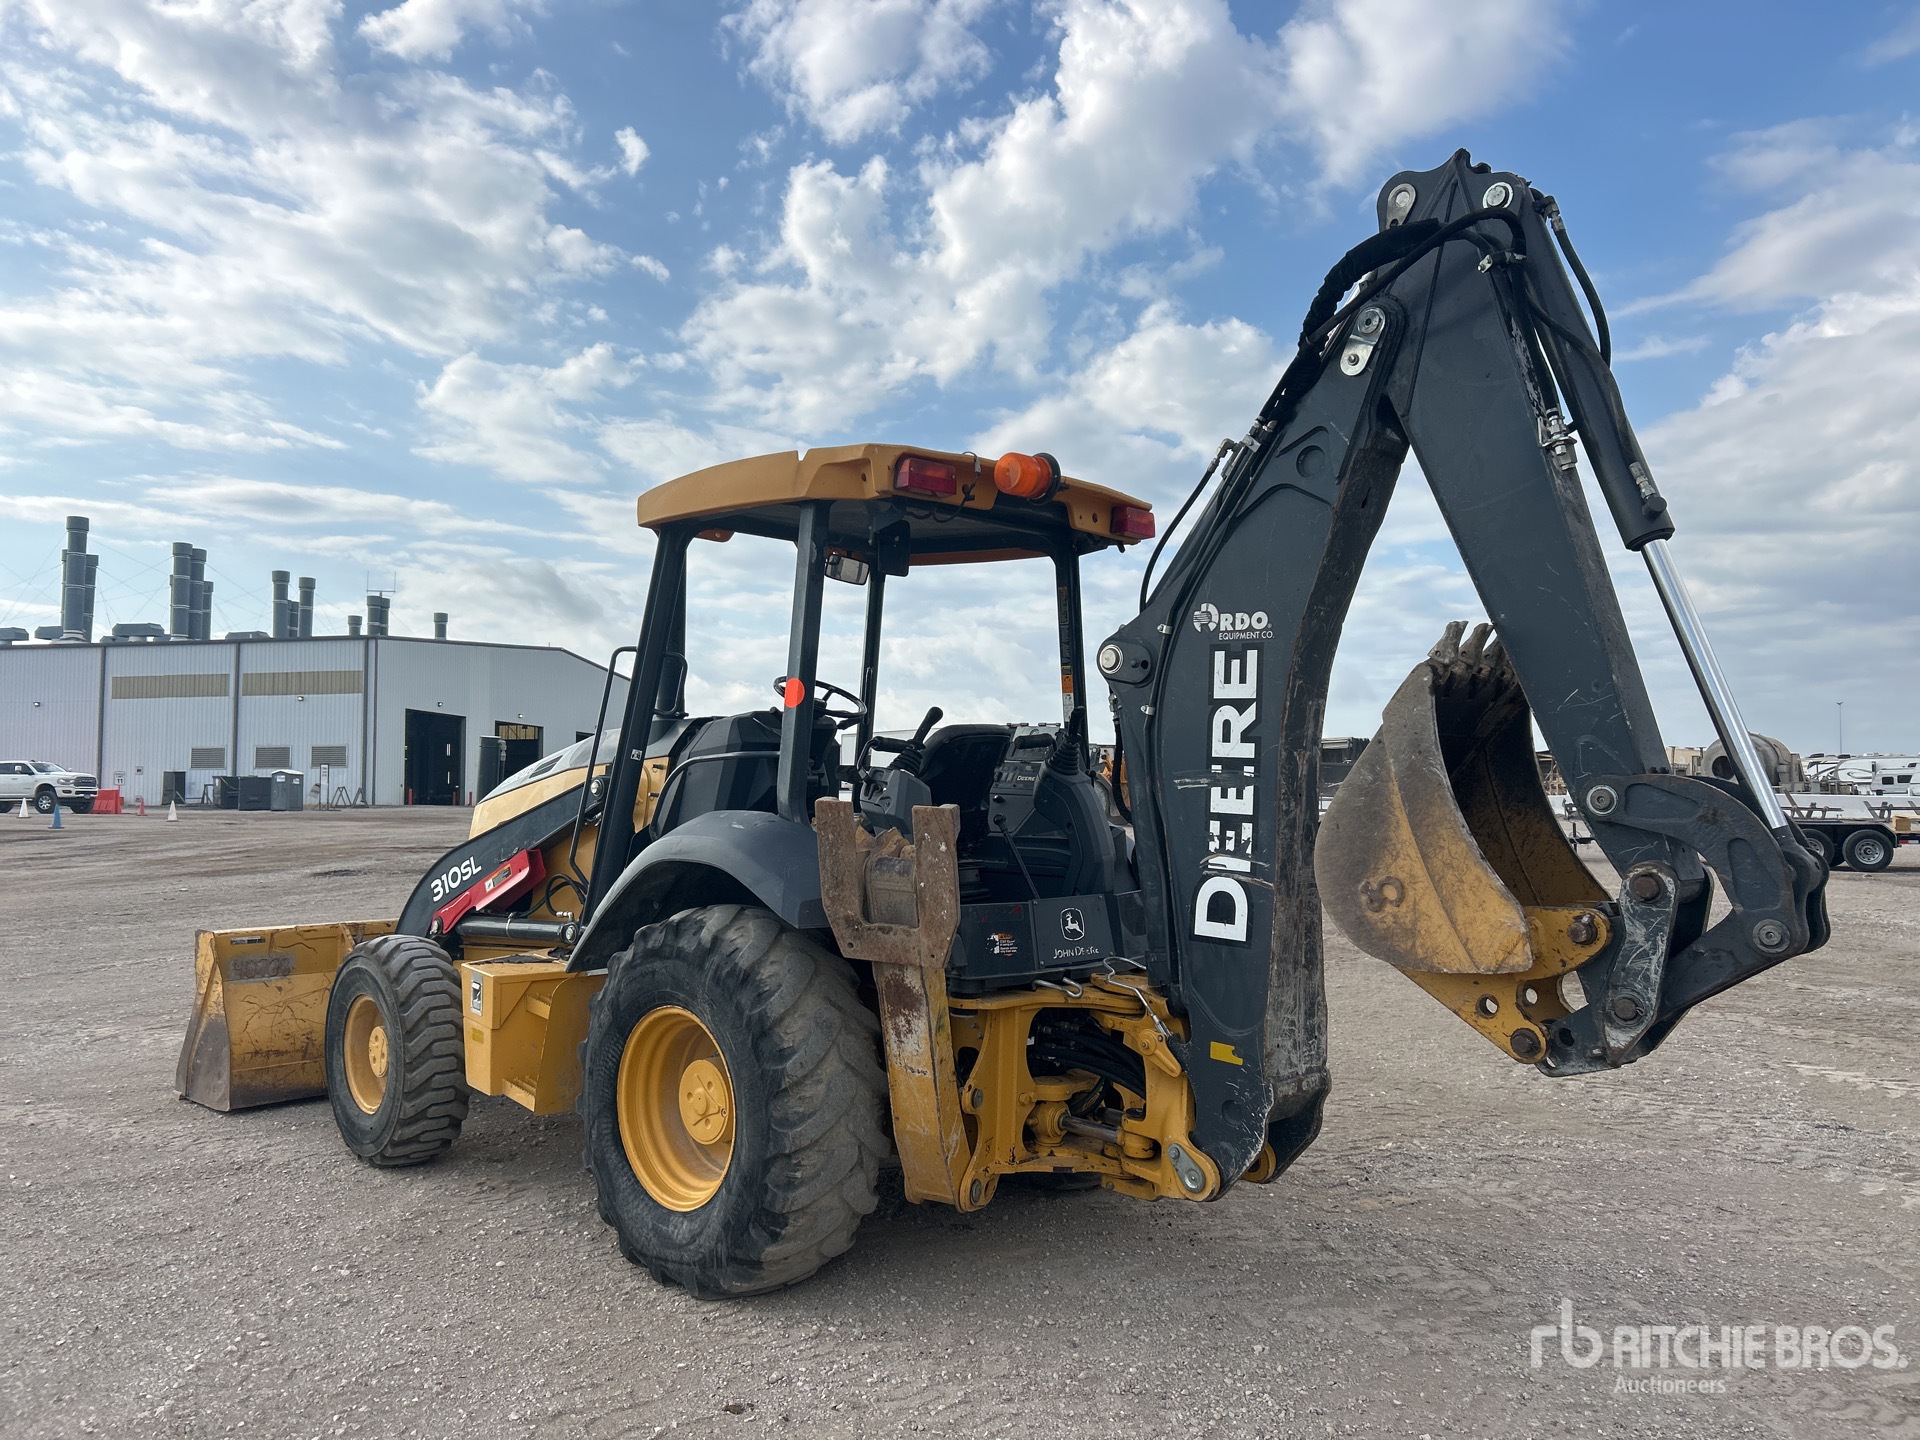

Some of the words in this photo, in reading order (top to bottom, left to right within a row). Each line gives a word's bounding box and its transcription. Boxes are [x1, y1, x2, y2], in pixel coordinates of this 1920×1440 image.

[1218, 632, 1260, 640] EQUIPMENT
[1261, 630, 1275, 639] CO.
[1194, 649, 1258, 942] DEERE
[430, 856, 482, 902] 310SL
[1053, 948, 1075, 959] JOHN
